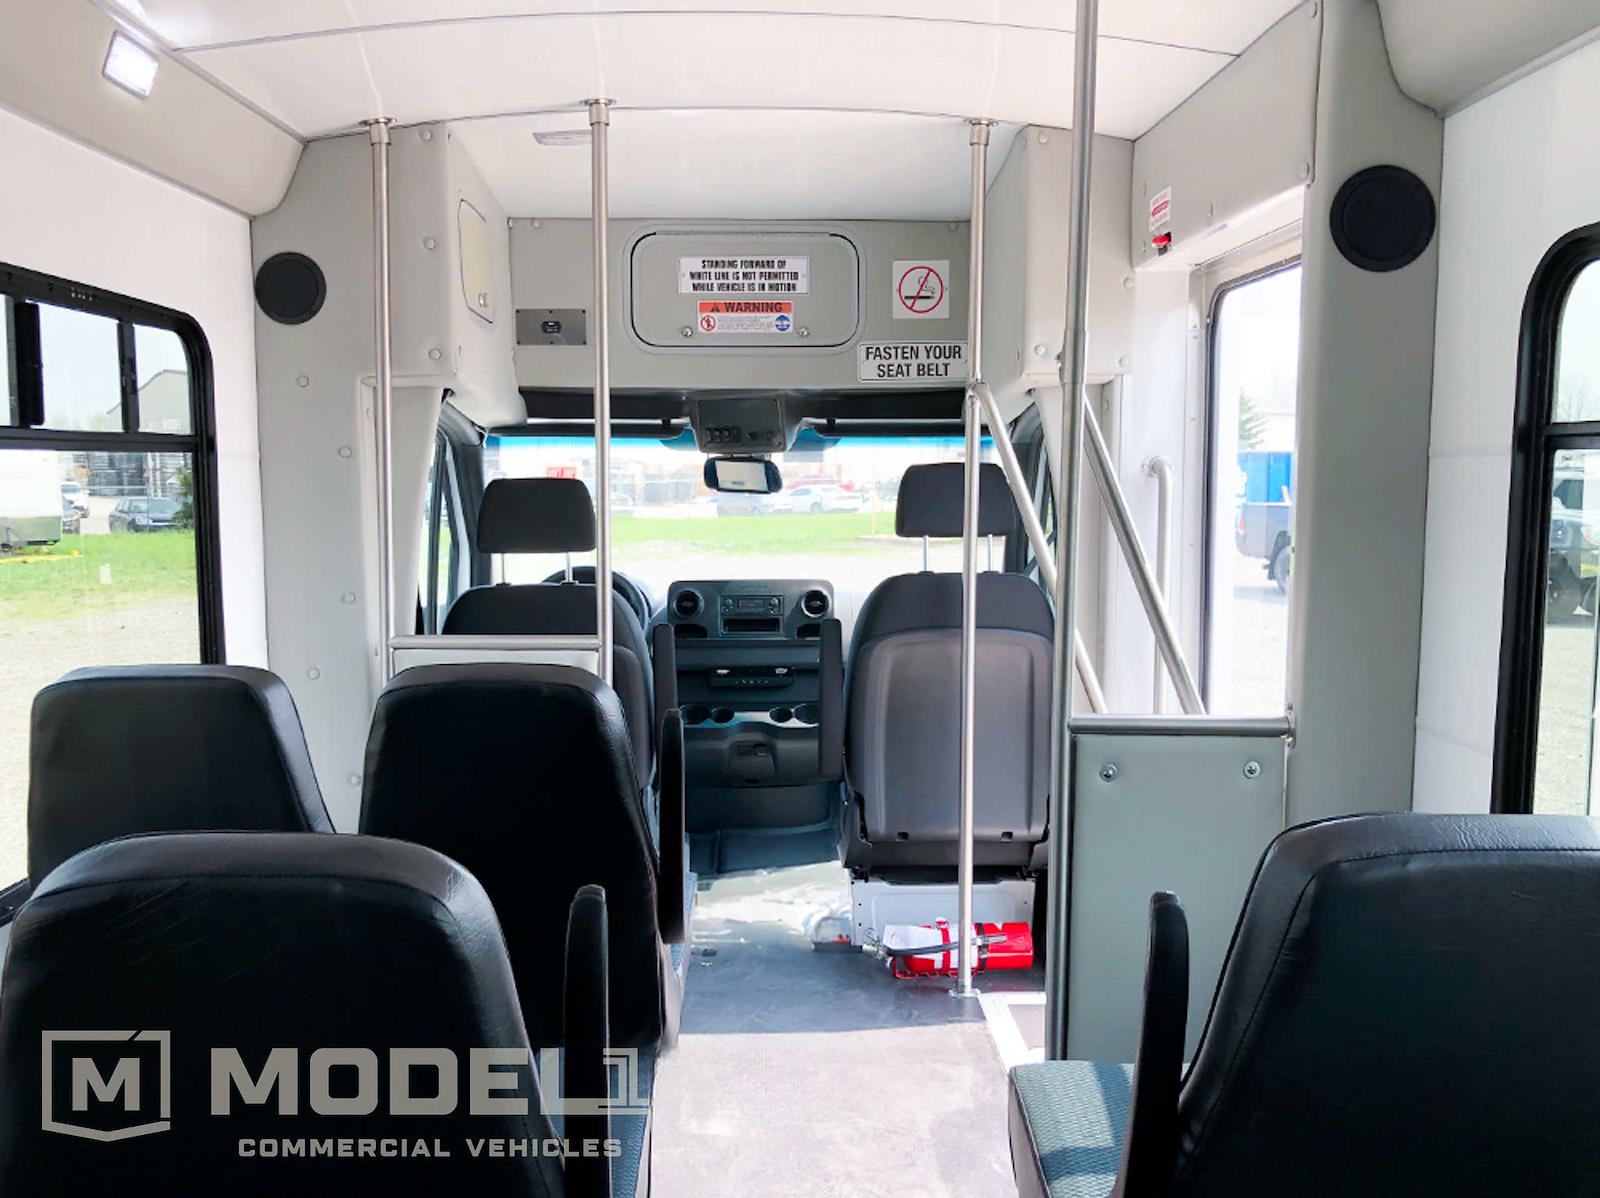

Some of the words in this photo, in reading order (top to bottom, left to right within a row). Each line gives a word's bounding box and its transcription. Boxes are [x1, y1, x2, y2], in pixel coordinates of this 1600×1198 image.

[701, 260, 738, 269] STANDING
[740, 260, 775, 269] FORWARD
[777, 260, 787, 269] OF
[689, 271, 713, 281] WHITE
[714, 271, 730, 281] LINE
[732, 271, 740, 281] IS
[742, 271, 757, 281] NOT
[759, 271, 799, 281] PERMITTED
[692, 282, 715, 292] WHILE
[716, 282, 745, 292] VEHICLE
[747, 282, 756, 292] IS
[758, 282, 766, 292] IN
[768, 282, 797, 292] MOTION
[724, 302, 783, 313] WARNING
[866, 345, 919, 360] FASTEN
[925, 345, 962, 359] YOUR
[877, 364, 912, 378] SEAT
[916, 363, 950, 377] BELT
